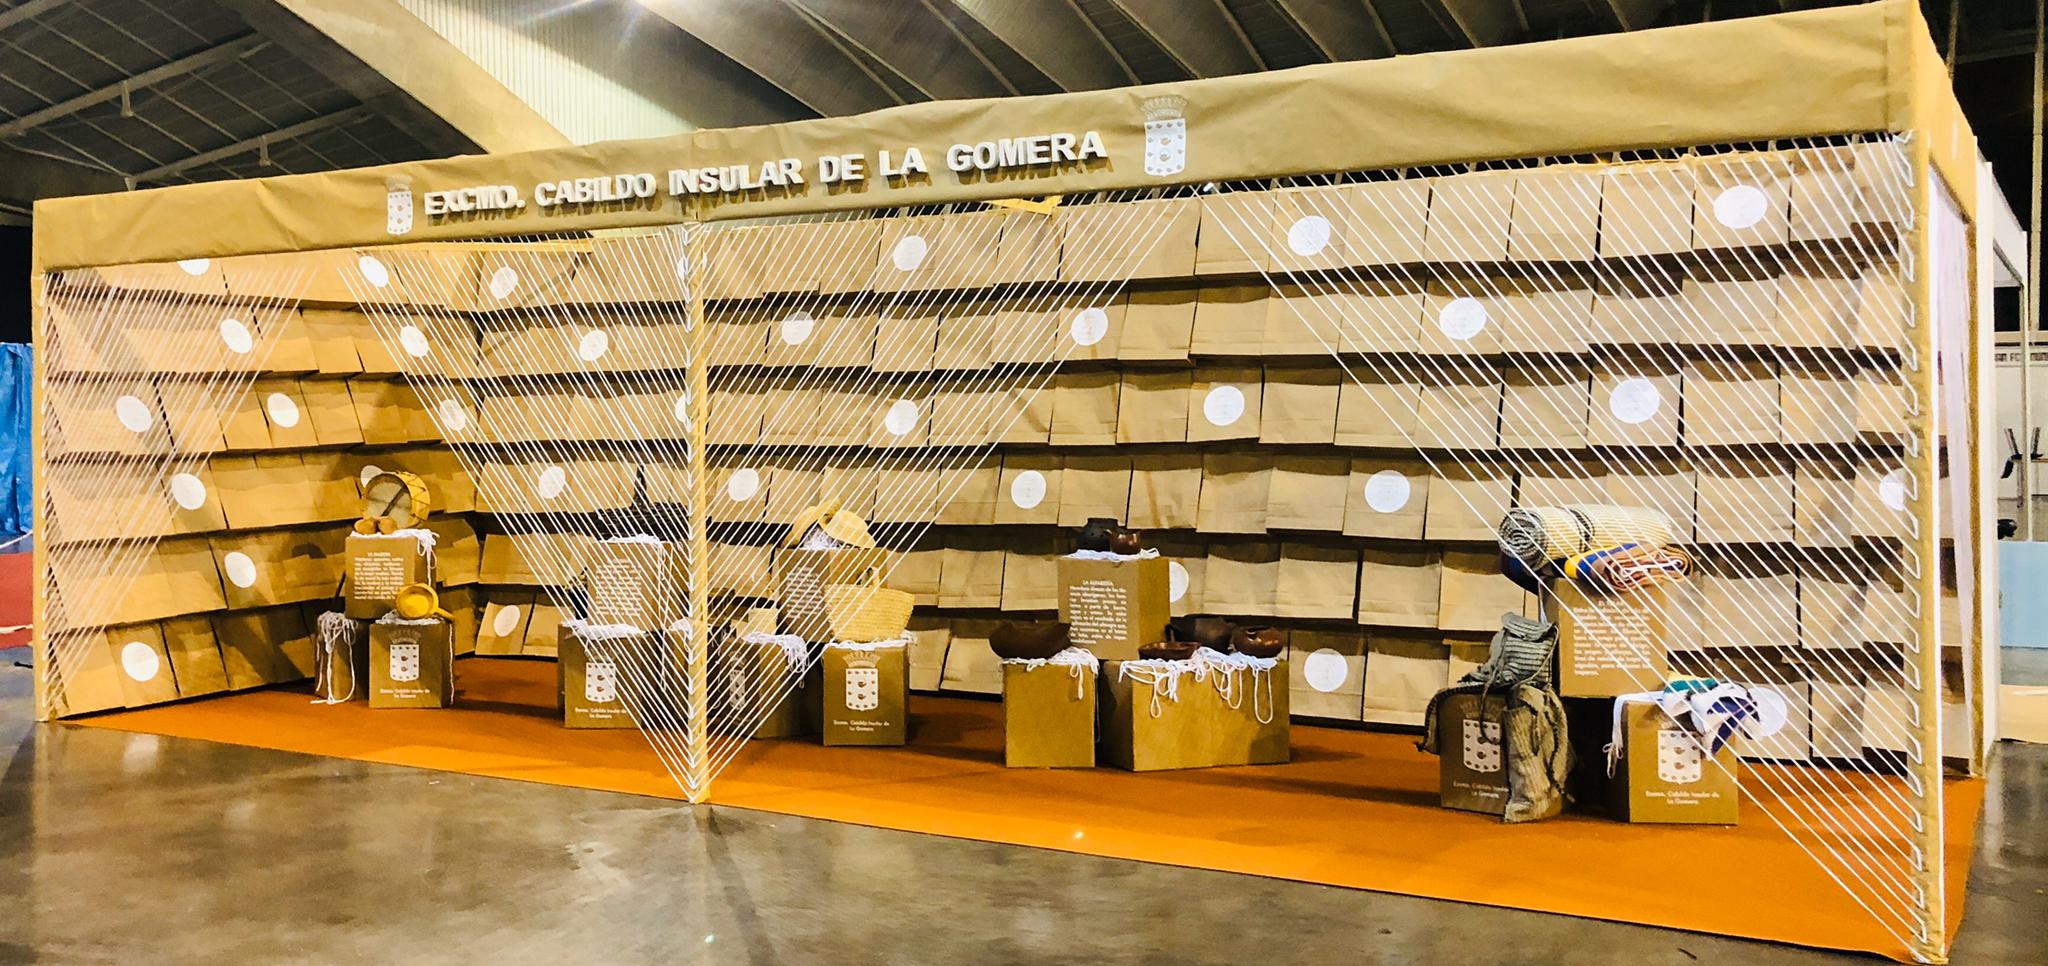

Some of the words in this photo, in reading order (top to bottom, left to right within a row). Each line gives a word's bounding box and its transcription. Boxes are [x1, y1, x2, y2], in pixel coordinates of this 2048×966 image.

[424, 185, 526, 215] EXCMO.
[534, 173, 657, 207] CABILDO
[667, 158, 804, 195] INSULAR
[818, 153, 865, 183] DE
[878, 147, 928, 177] LA
[946, 130, 1109, 172] GOMERA
